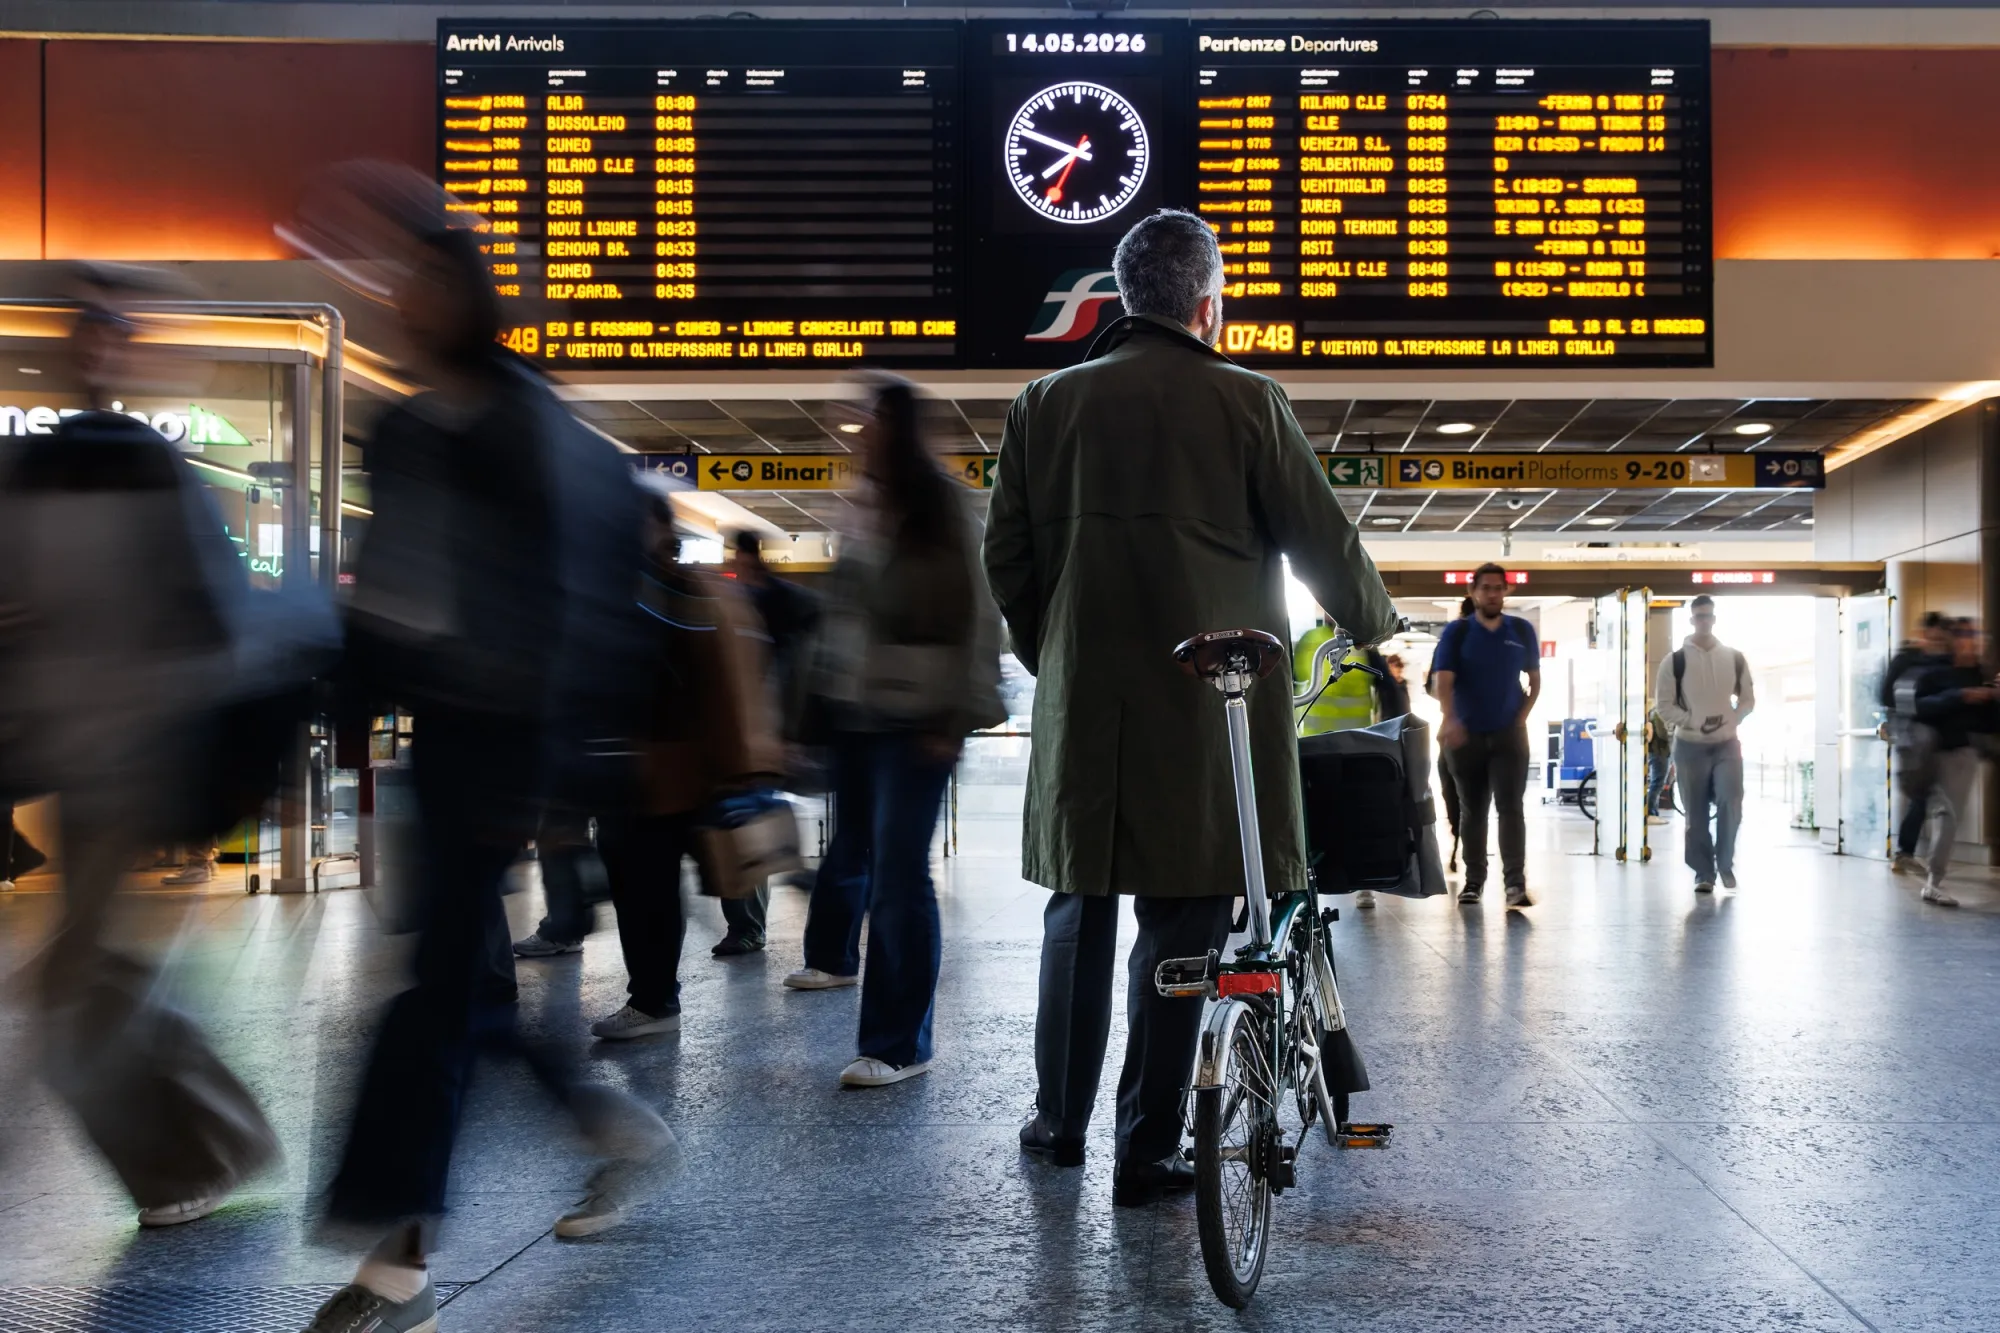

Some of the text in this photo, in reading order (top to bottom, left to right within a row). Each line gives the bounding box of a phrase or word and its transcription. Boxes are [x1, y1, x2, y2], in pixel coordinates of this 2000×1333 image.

[446, 35, 565, 51] Arrivi Arrivals
[1006, 33, 1146, 52] 14.05.2026
[1199, 36, 1379, 54] Partenze Departures
[547, 96, 583, 110] ALBA
[656, 96, 695, 110] 08:00
[1300, 95, 1349, 110] MILANO
[1408, 95, 1446, 110] 07:54
[1648, 95, 1664, 110] 17
[547, 116, 625, 131] BUSSOLENO
[656, 116, 692, 130] 08:01
[1408, 116, 1447, 131] 08:00
[1648, 116, 1665, 131] 15
[547, 138, 591, 152] CUNEO
[656, 138, 695, 152] 08:05
[1300, 137, 1358, 152] VENEZIA
[1408, 137, 1447, 151] 08:05
[1648, 137, 1664, 151] 14
[547, 158, 597, 173] MILANO
[656, 158, 695, 173] 08:06
[1301, 157, 1393, 172] SALBERTRAND
[1408, 157, 1444, 172] 08:15
[547, 180, 583, 194] SUSA
[656, 179, 693, 194] 08:15
[1301, 178, 1385, 193] VENTIMIGLIA
[1408, 179, 1447, 193] 08:25
[547, 200, 583, 215] CEVA
[656, 200, 693, 214] 08:15
[1301, 199, 1341, 214] IVREA
[1408, 199, 1447, 214] 08:25
[1564, 199, 1601, 214] SUSA
[547, 221, 580, 236] NOVI
[587, 221, 637, 236] LIGURE
[656, 221, 696, 236] 08:23
[1301, 220, 1336, 235] ROMA
[1343, 220, 1397, 235] TERMINI
[1408, 220, 1447, 234] 08:30
[493, 242, 516, 255] 2116
[547, 242, 600, 256] GENOVA
[656, 242, 695, 257] 08:33
[1301, 241, 1333, 255] ASTI
[1408, 241, 1447, 255] 08:30
[547, 263, 592, 278] CUNEO
[656, 263, 695, 278] 08:35
[1301, 262, 1350, 276] NAPOLI
[1408, 262, 1447, 276] 08:40
[656, 284, 695, 298] 08:35
[1301, 282, 1336, 297] SUSA
[1408, 282, 1447, 297] 08:45
[574, 322, 585, 336] E
[591, 322, 653, 336] FOSSANO
[676, 322, 721, 336] CUNEO
[744, 321, 794, 336] LIMONE
[800, 321, 884, 336] CANCELLATI
[890, 321, 917, 336] TRA
[923, 321, 956, 336] CUNE
[1549, 319, 1578, 335] DAL
[1606, 319, 1627, 335] AL
[1631, 319, 1649, 335] 21
[1654, 319, 1706, 335] MAGGIO
[1226, 324, 1294, 352] 07:48
[566, 342, 623, 358] VIETATO
[630, 342, 732, 358] OLTREPASSARE
[740, 342, 758, 358] LA
[765, 342, 806, 358] LINEA
[813, 342, 863, 358] GIALLA
[1321, 340, 1378, 356] VIETATO
[1384, 340, 1486, 356] OLTREPASSARE
[1493, 340, 1511, 356] LA
[1518, 340, 1559, 356] LINEA
[1565, 340, 1616, 356] GIALLA
[761, 461, 833, 481] Binari
[1452, 460, 1685, 480] Binari Platforms 9-20
